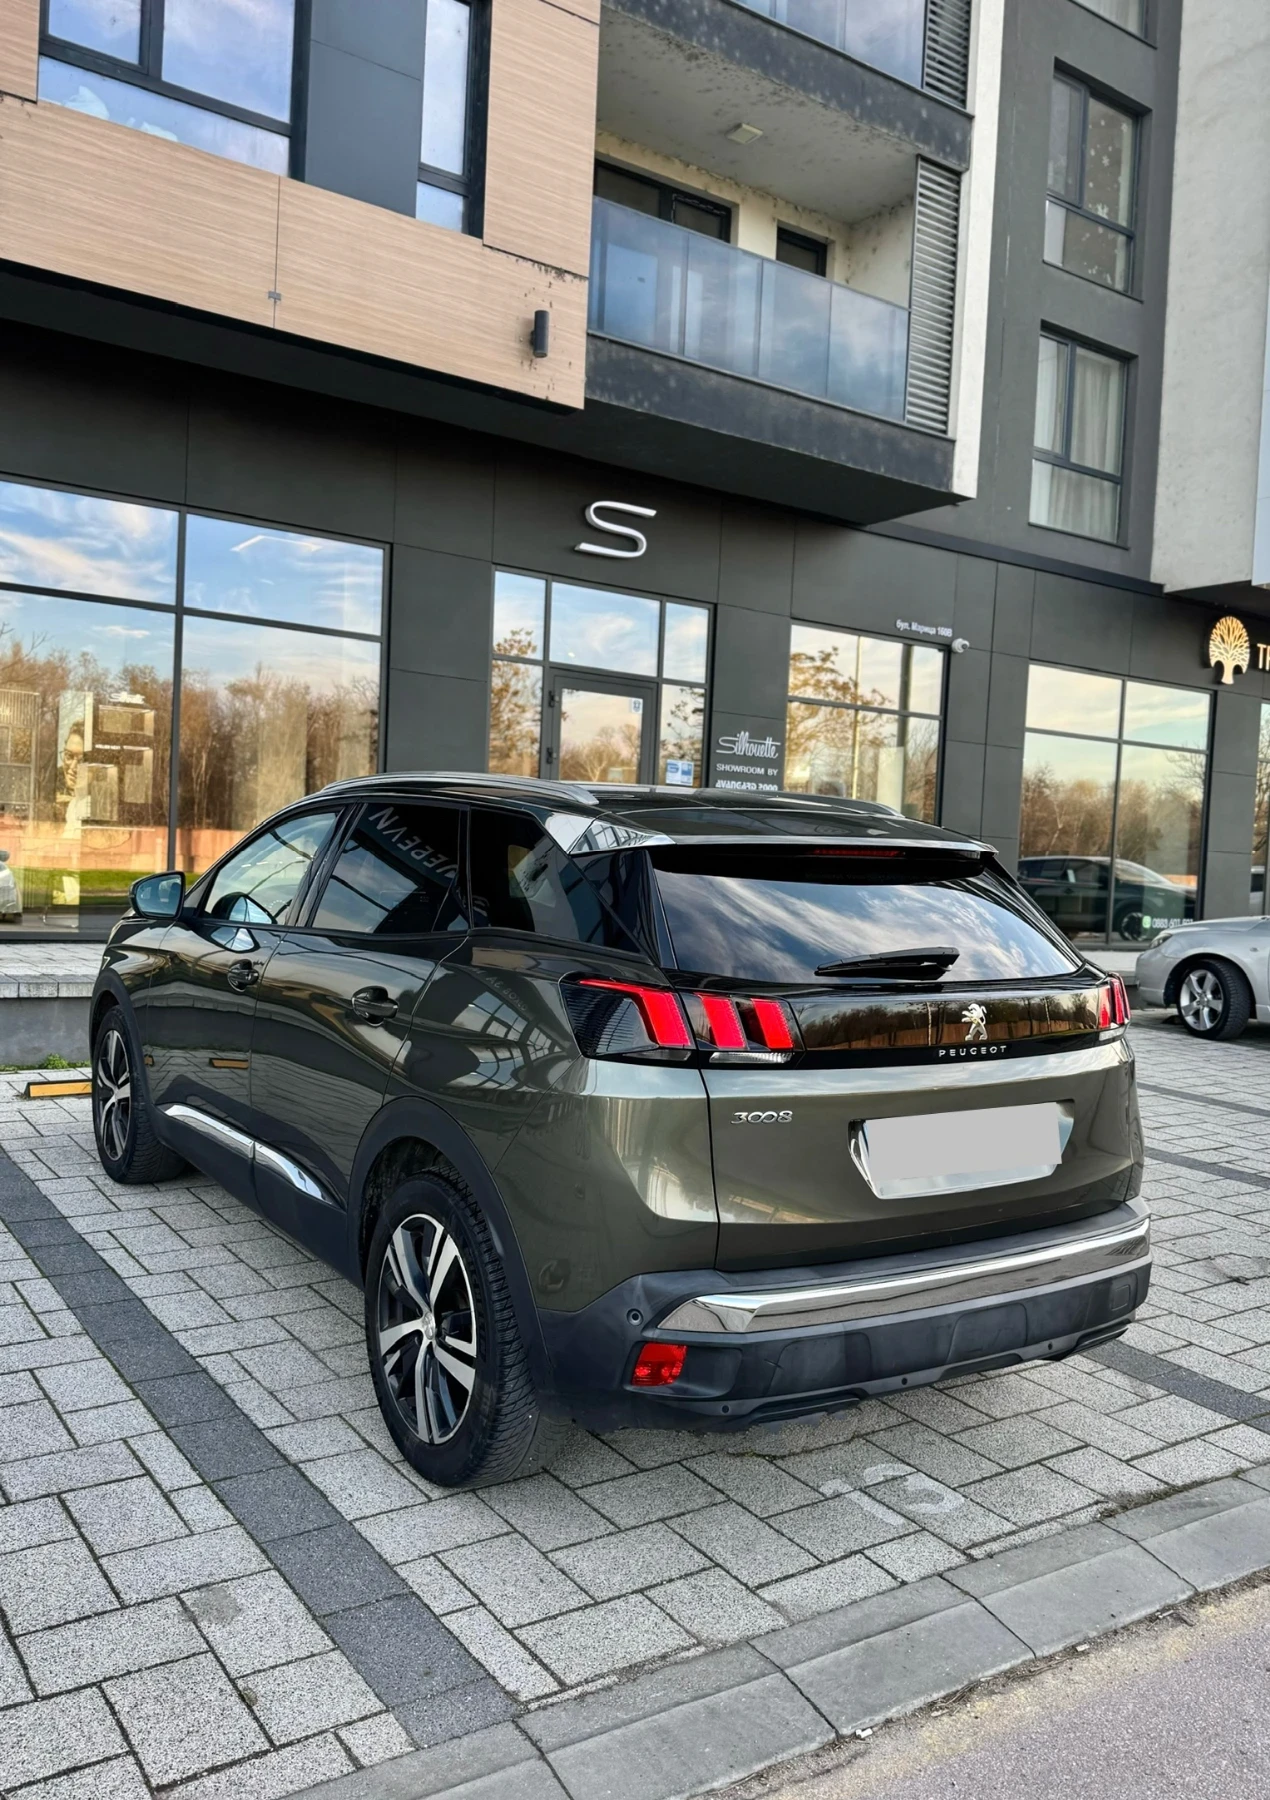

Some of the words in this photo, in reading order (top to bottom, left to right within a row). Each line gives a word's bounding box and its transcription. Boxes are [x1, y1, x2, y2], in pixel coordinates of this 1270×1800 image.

[575, 501, 657, 559] S
[716, 731, 781, 759] Silhouette
[716, 763, 765, 775] SHOWROOM
[767, 768, 779, 776] BY
[938, 1045, 1007, 1057] PEUGEOT
[731, 1110, 793, 1123] 3008
[819, 1463, 965, 1526] 13
